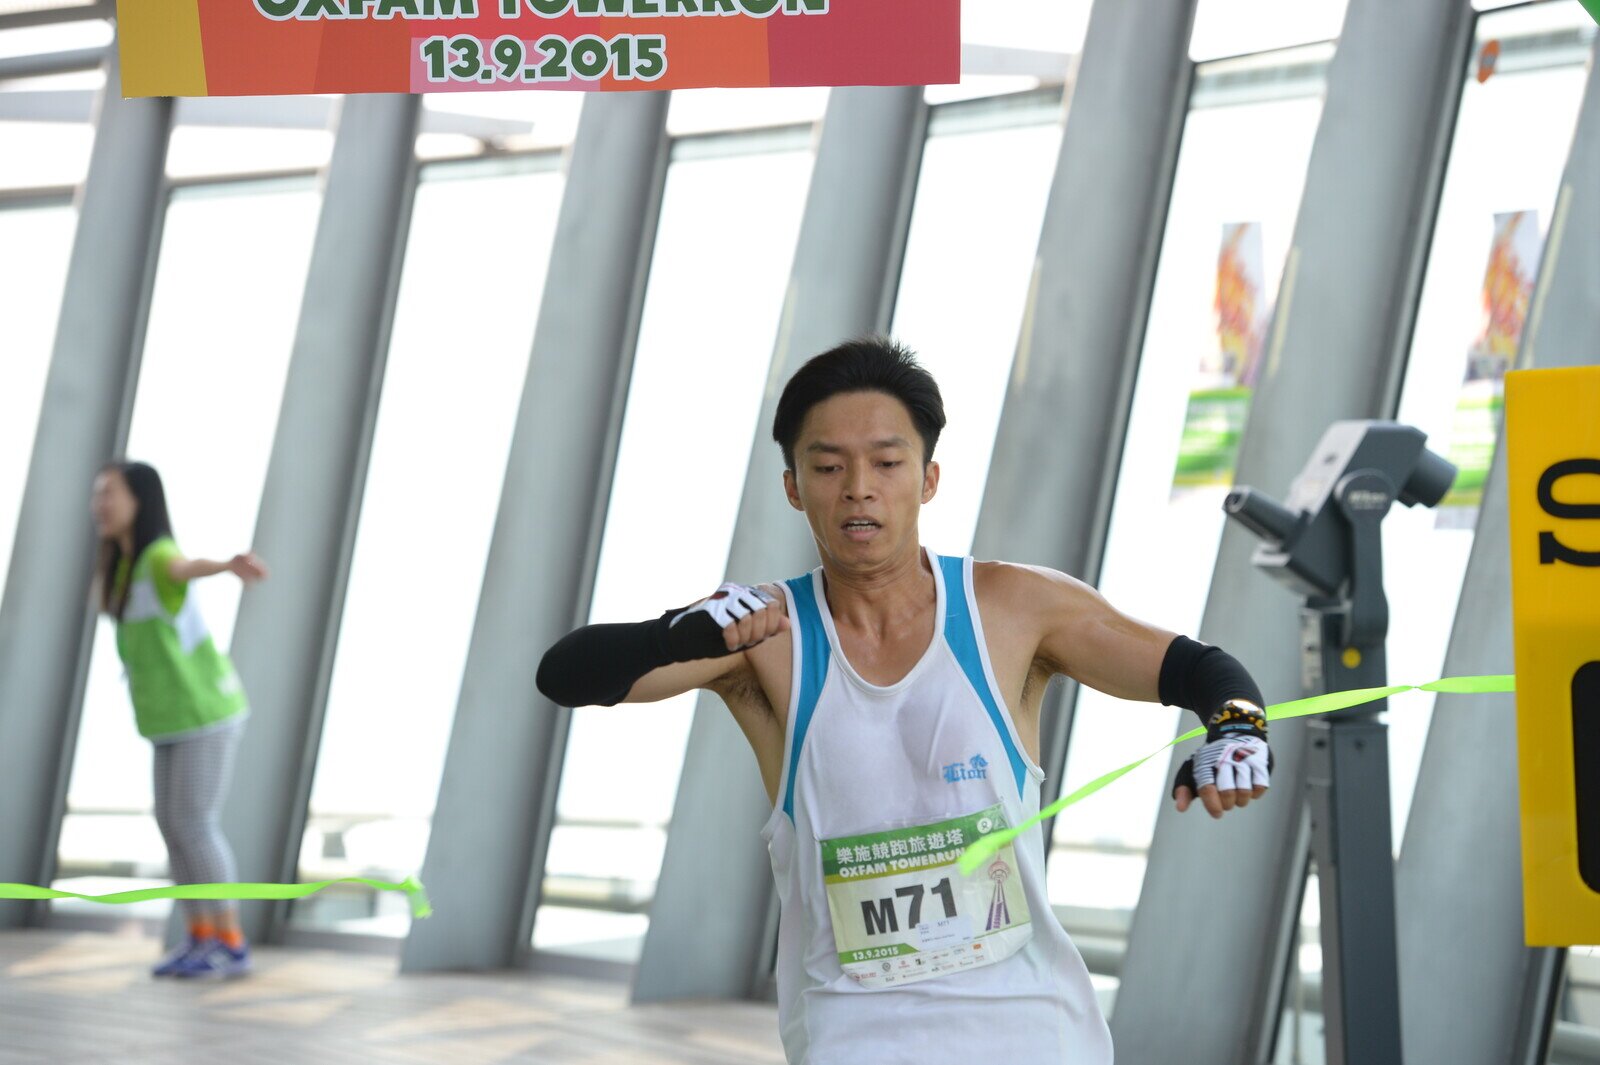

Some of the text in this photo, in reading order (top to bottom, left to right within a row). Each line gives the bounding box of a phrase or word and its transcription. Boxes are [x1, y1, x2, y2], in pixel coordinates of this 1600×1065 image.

[421, 36, 666, 81] 13.9.2015
[943, 762, 987, 783] Lion
[836, 829, 964, 864] 樂施競跑旅遊塔
[839, 847, 965, 878] OXFAM TOWERRUN
[861, 877, 957, 936] M71
[852, 947, 899, 961] 13.9.2015
